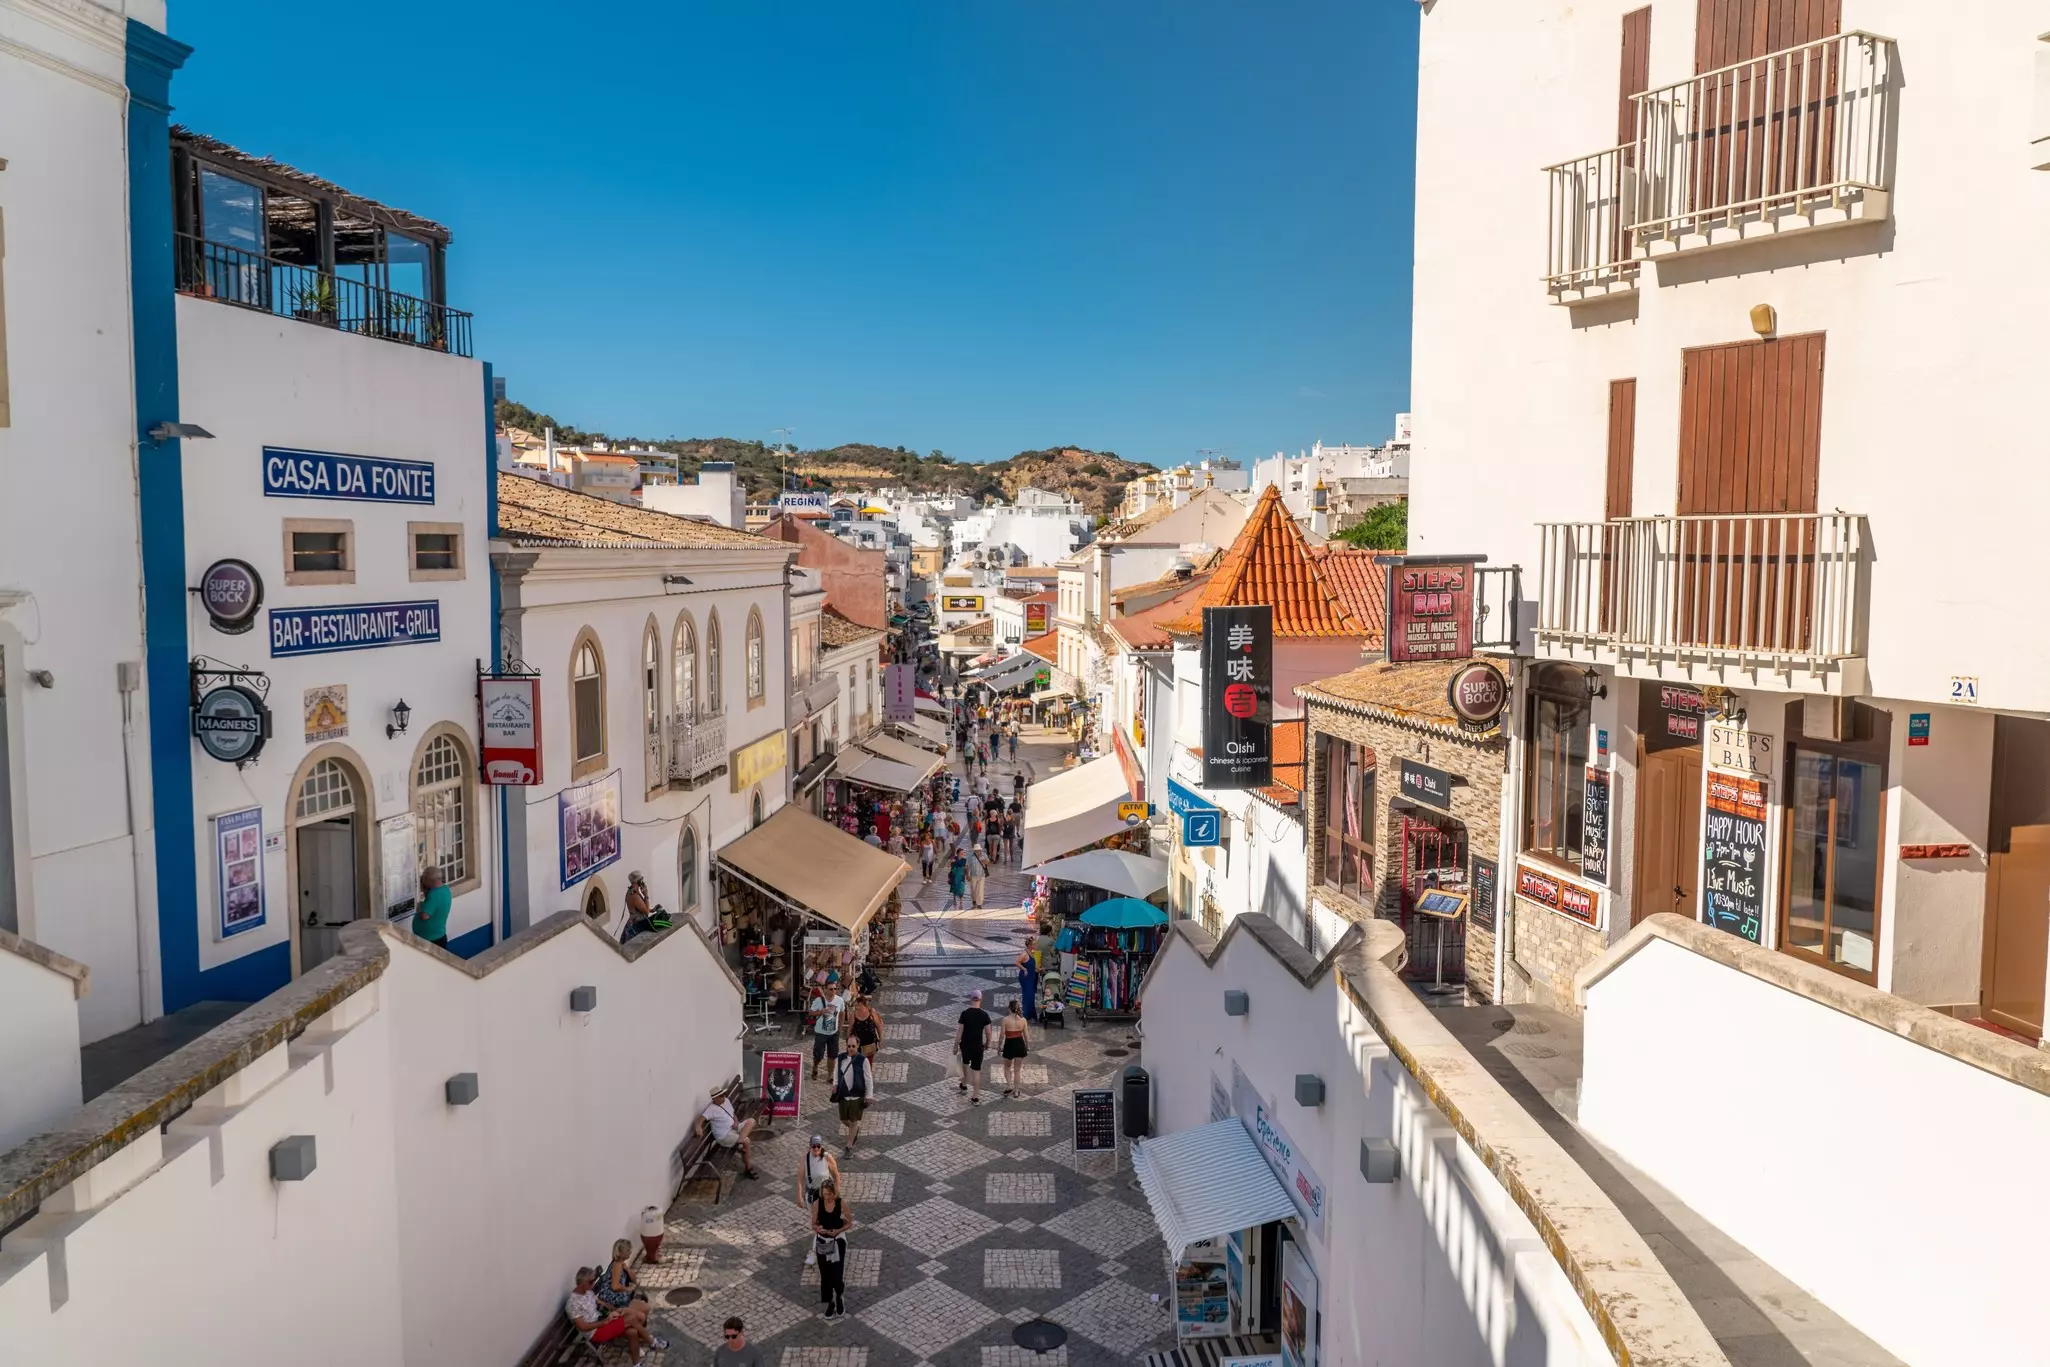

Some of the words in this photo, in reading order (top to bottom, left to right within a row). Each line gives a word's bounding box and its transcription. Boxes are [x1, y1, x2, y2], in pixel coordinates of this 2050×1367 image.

[267, 457, 330, 490] CASA
[336, 463, 366, 493] DA
[372, 466, 432, 497] FONTE
[784, 497, 821, 506] REGINA
[208, 579, 246, 591] SUPER
[1403, 567, 1463, 590] STEPS
[210, 591, 244, 603] BOCK
[1413, 593, 1452, 615] BAR
[1407, 623, 1426, 633] LIVE
[1431, 622, 1457, 632] MUSIC
[1408, 644, 1437, 653] SPORTS
[1440, 643, 1455, 651] BAR
[1462, 681, 1498, 694] SUPER
[1952, 681, 1975, 697] 2A
[1465, 692, 1497, 705] BOCK
[1661, 686, 1705, 714] STEPS
[200, 718, 256, 731] MAGNERS
[1465, 724, 1482, 732] STEPS
[1482, 720, 1494, 731] BAR
[1668, 713, 1698, 739] BAR
[1712, 729, 1770, 752] STEPS
[1241, 756, 1268, 764] japanese
[1723, 750, 1757, 771] BAR
[1587, 783, 1604, 798] LIVE
[1711, 782, 1738, 802] STEPS
[1586, 797, 1608, 812] SPORT
[1707, 814, 1733, 842] HAPPY
[1735, 819, 1765, 851] HOUR
[1584, 844, 1605, 861] HAPPY
[1522, 871, 1559, 904] STEPS
[1563, 886, 1590, 917] BAR
